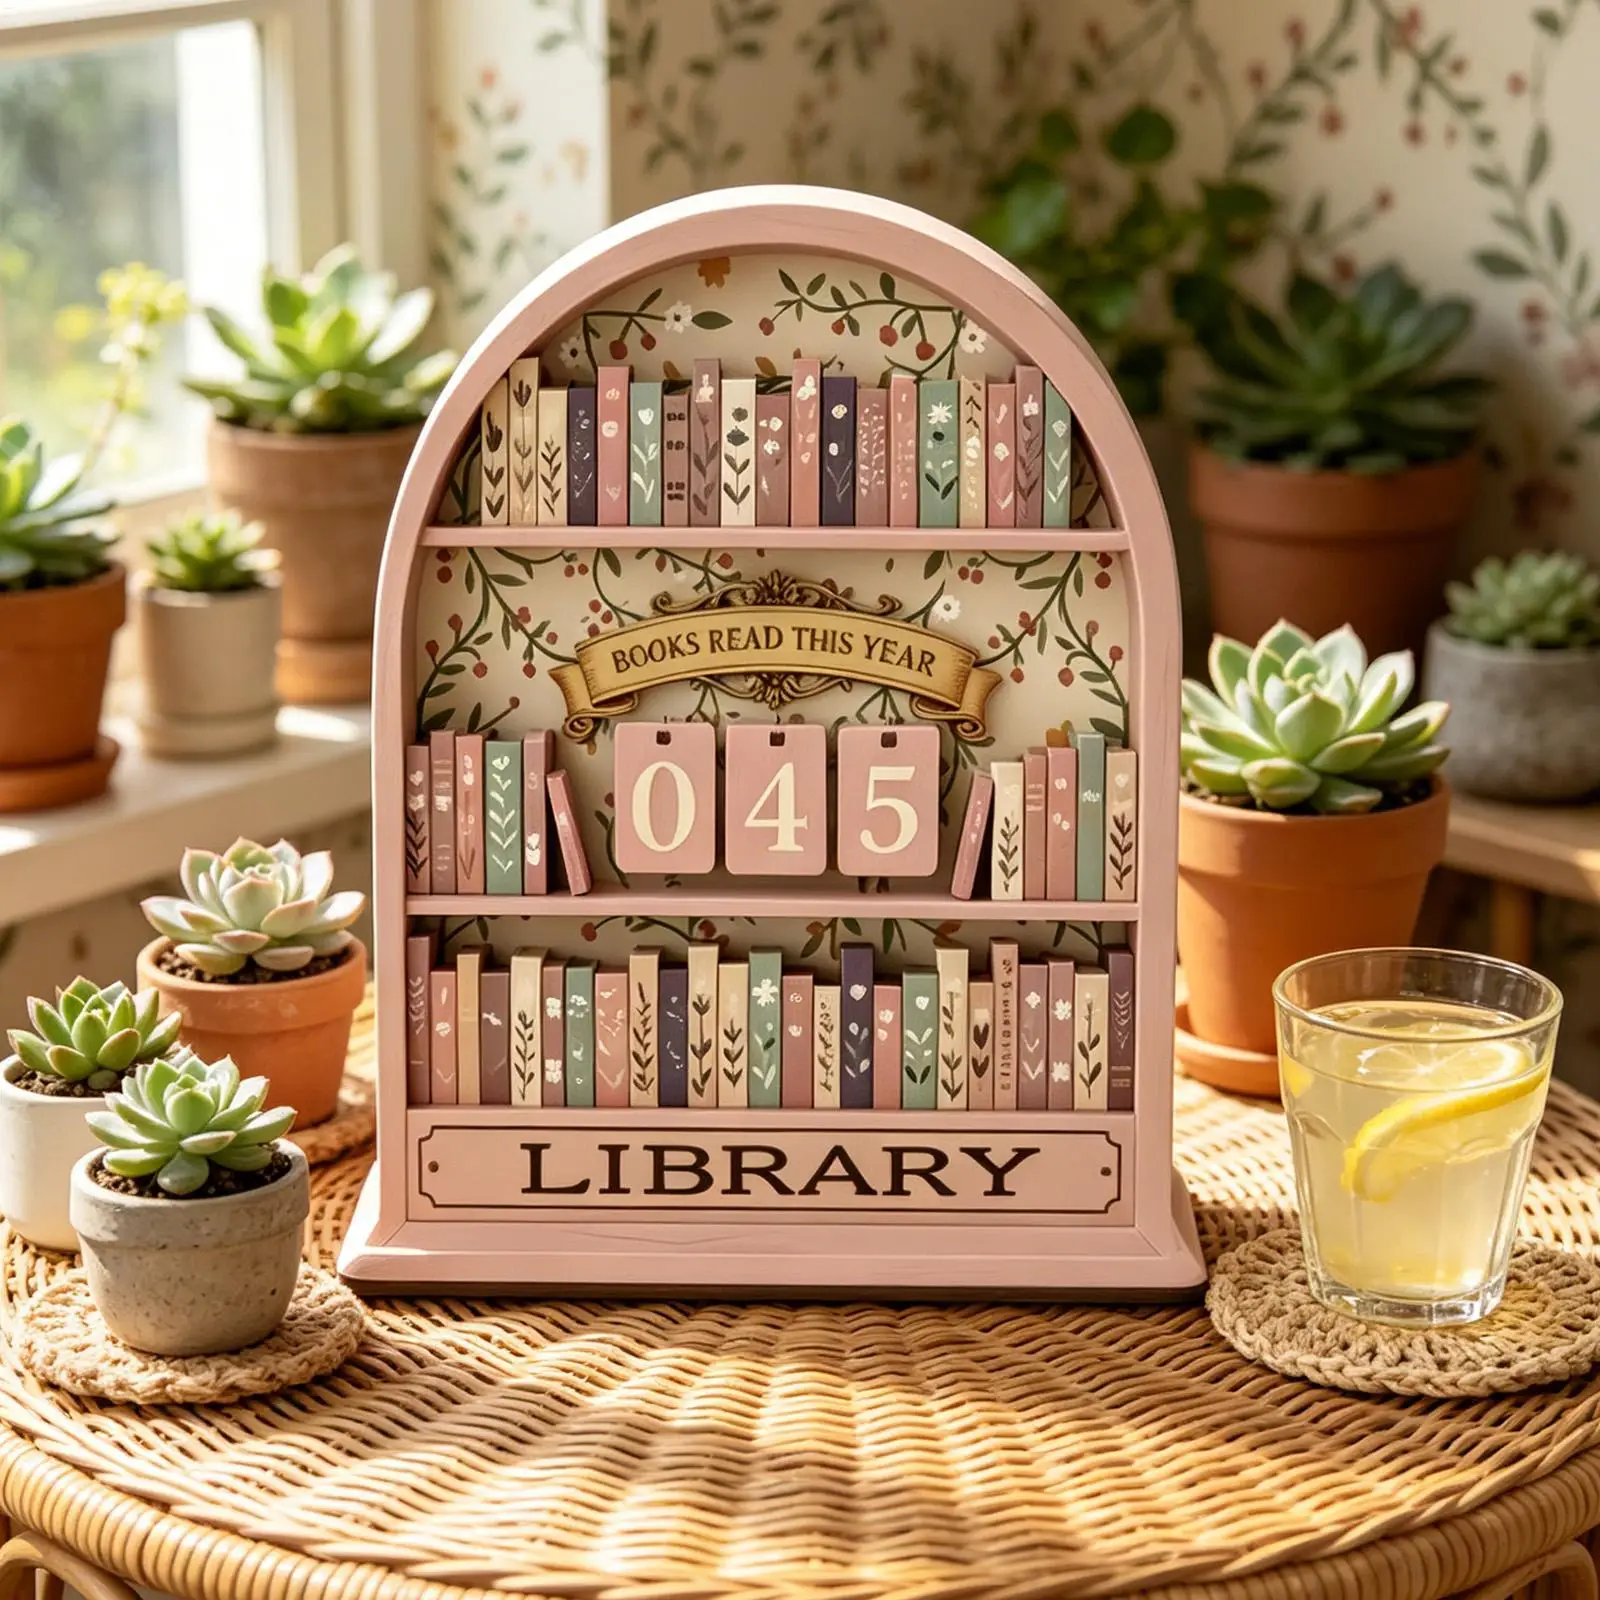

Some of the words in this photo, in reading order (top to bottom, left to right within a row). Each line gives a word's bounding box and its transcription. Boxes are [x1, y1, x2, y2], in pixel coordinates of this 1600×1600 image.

[611, 632, 701, 674] BOOKS
[709, 625, 784, 654] READ
[791, 626, 854, 655] THIS
[863, 635, 937, 677] YEAR
[520, 1143, 1041, 1197] LIBRARY
